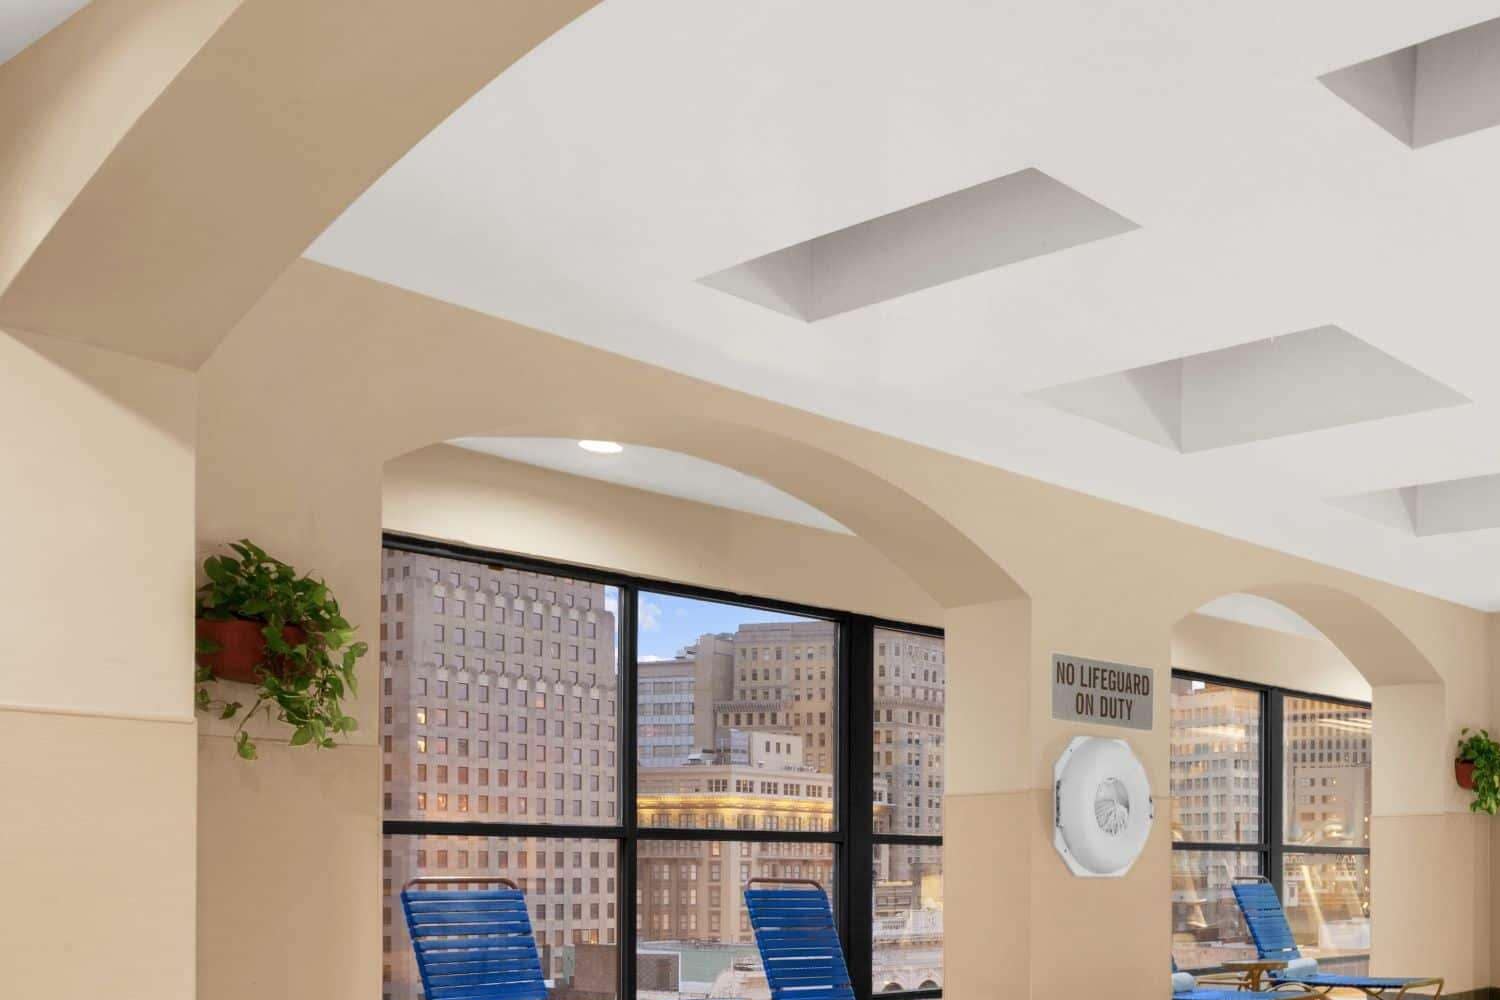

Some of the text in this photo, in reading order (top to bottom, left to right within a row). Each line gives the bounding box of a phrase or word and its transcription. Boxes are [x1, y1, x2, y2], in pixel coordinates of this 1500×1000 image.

[1056, 661, 1150, 697] NO LIFEGUARD
[1076, 692, 1133, 721] ON DUTY
